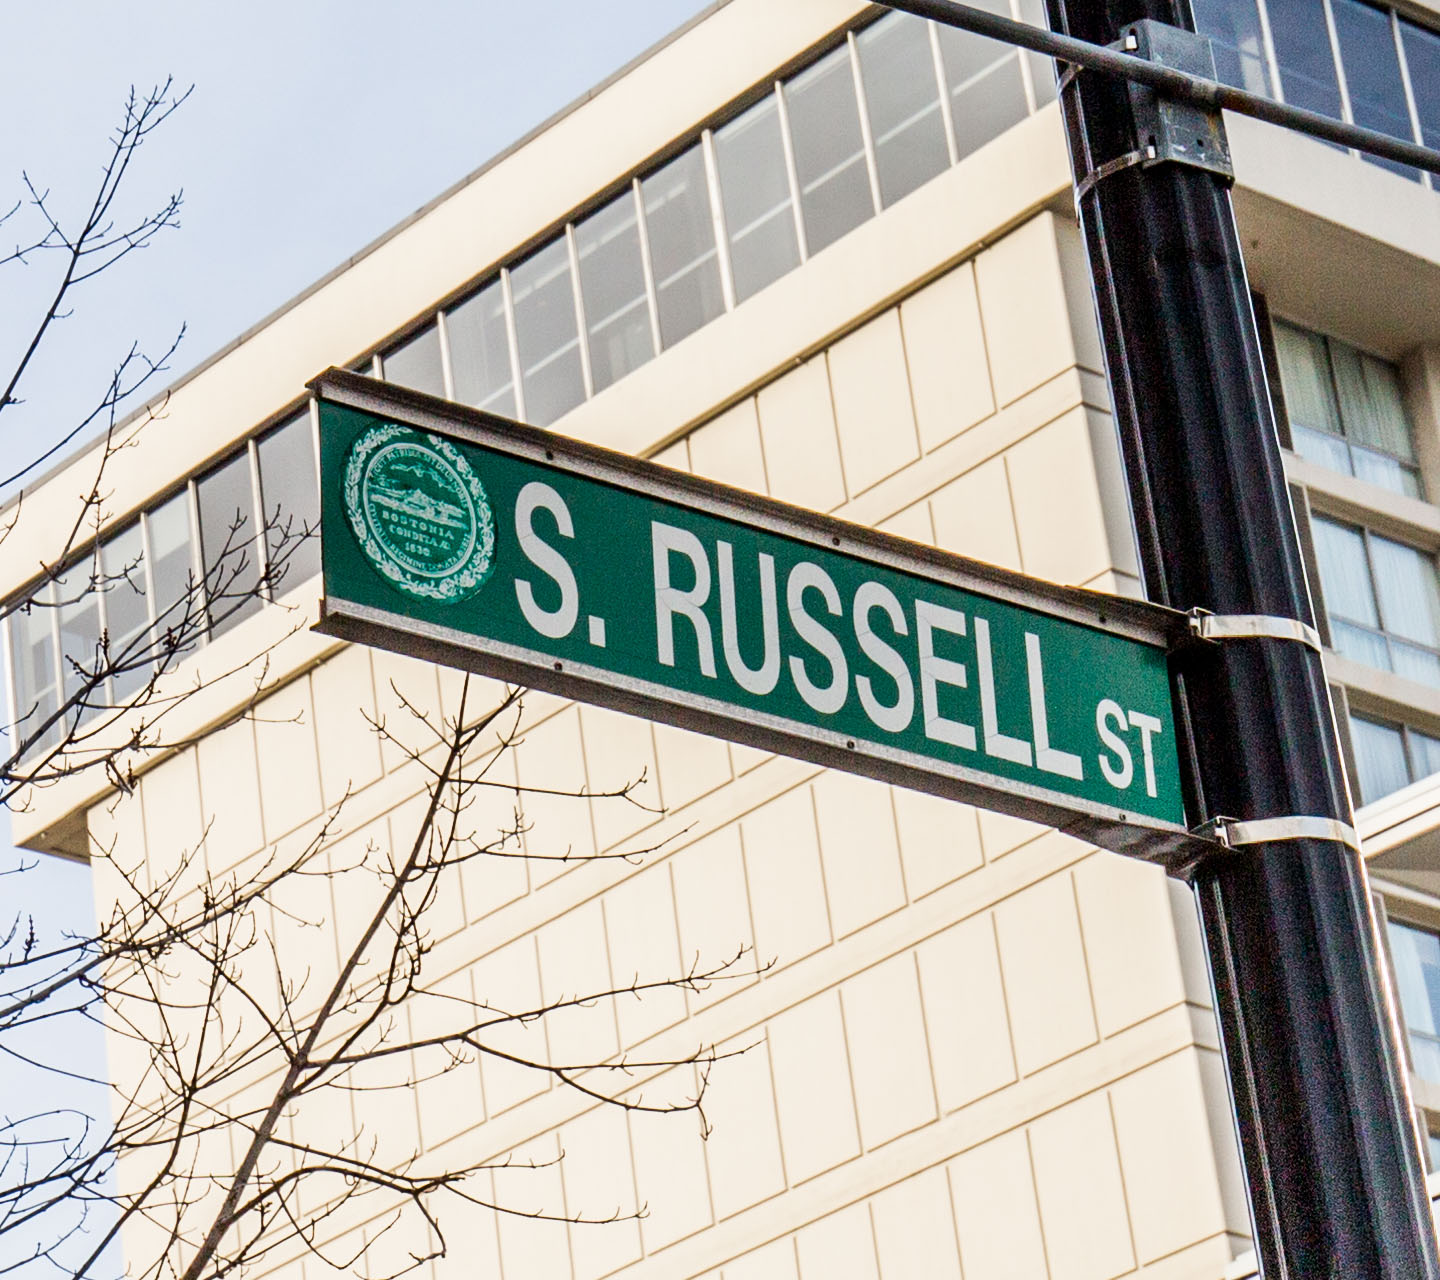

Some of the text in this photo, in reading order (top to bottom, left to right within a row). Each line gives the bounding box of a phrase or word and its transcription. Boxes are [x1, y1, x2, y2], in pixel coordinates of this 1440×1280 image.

[382, 510, 455, 540] BOSTONIA
[515, 480, 1162, 798] S. RUSSELL ST
